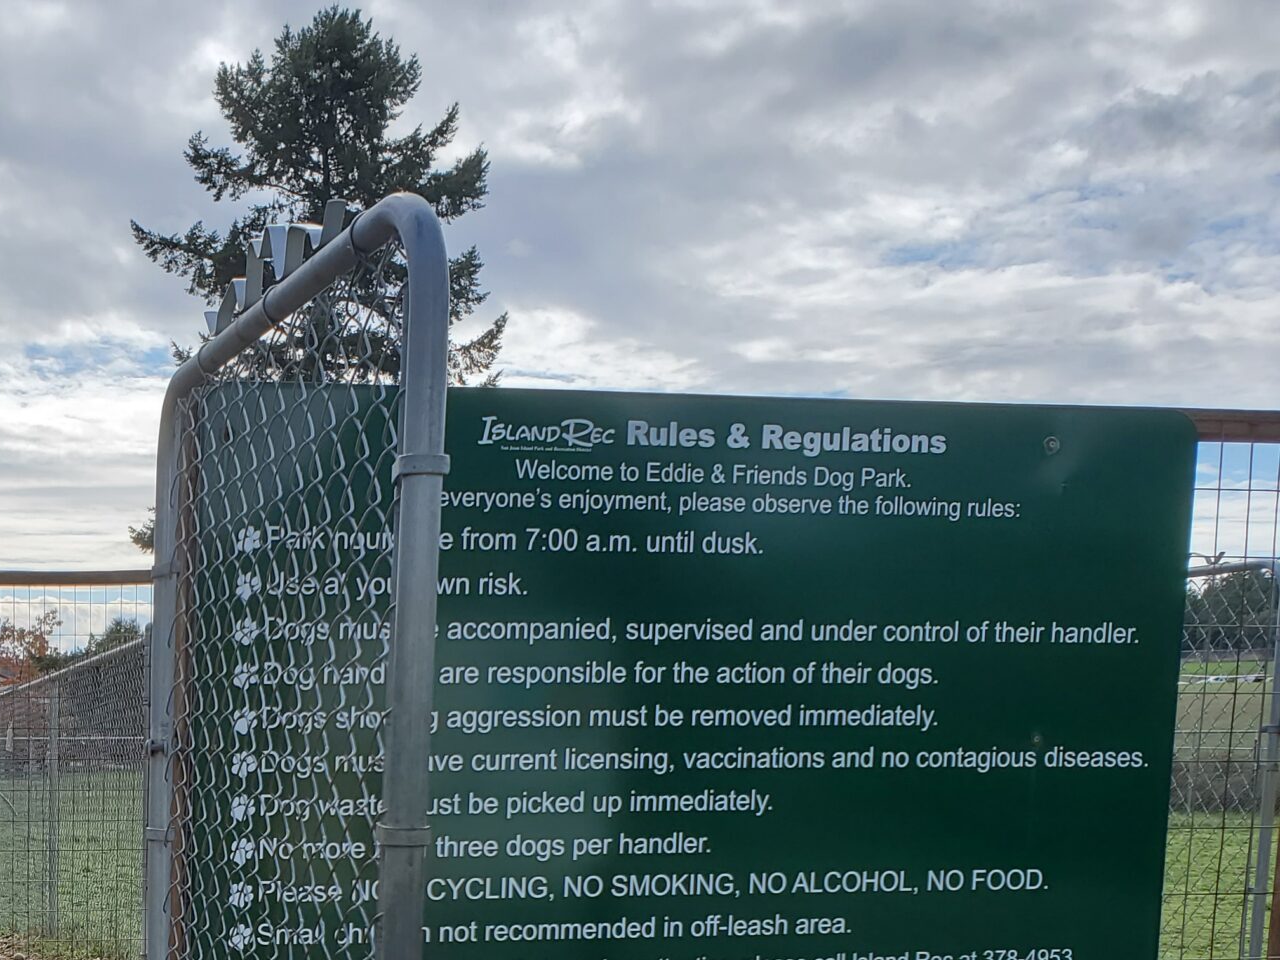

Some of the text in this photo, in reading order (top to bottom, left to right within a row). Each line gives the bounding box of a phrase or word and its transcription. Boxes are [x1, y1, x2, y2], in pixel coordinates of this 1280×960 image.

[627, 420, 715, 447] Rules
[726, 423, 750, 448] &
[761, 424, 946, 455] Regulations
[515, 459, 910, 491] Welcome to Eddie & Friends Dog Park.
[558, 490, 671, 513] enjoyment,
[679, 492, 745, 514] please
[752, 493, 831, 513] observe
[838, 495, 868, 514] the
[874, 495, 960, 520] following
[967, 498, 1020, 517] rules:
[270, 526, 325, 549] Park
[461, 526, 516, 550] from
[525, 527, 577, 551] 7:00
[585, 534, 636, 551] a.m.
[646, 530, 694, 552] until
[702, 531, 762, 553] dusk.
[478, 573, 527, 594] risk.
[267, 617, 329, 645] Dogs
[447, 617, 616, 643] accompanied,
[625, 618, 752, 644] supervised
[760, 619, 803, 640] and
[811, 619, 877, 641] under
[883, 620, 958, 641] control
[966, 620, 989, 642] of
[994, 621, 1045, 642] their
[1050, 621, 1138, 643] handler.
[264, 660, 937, 690] Dog are responsible for the action of their dogs.
[262, 704, 937, 734] Dogs aggression must be removed immediately.
[261, 746, 1148, 778] Dogs current licensing, vaccinations and no contagious diseases.
[260, 789, 772, 822] Dog be picked up immediately.
[260, 838, 294, 859] No
[435, 836, 498, 857] three
[506, 834, 564, 861] dogs
[572, 838, 612, 860] per
[619, 832, 710, 853] handler.
[427, 876, 553, 900] CYCLING,
[563, 875, 603, 897] NO
[611, 873, 739, 896] SMOKING,
[749, 872, 786, 893] NO
[791, 870, 917, 893] ALCOHOL,
[927, 869, 963, 890] NO
[971, 868, 1048, 890] FOOD.
[439, 914, 851, 942] not recommended in off-leash area.
